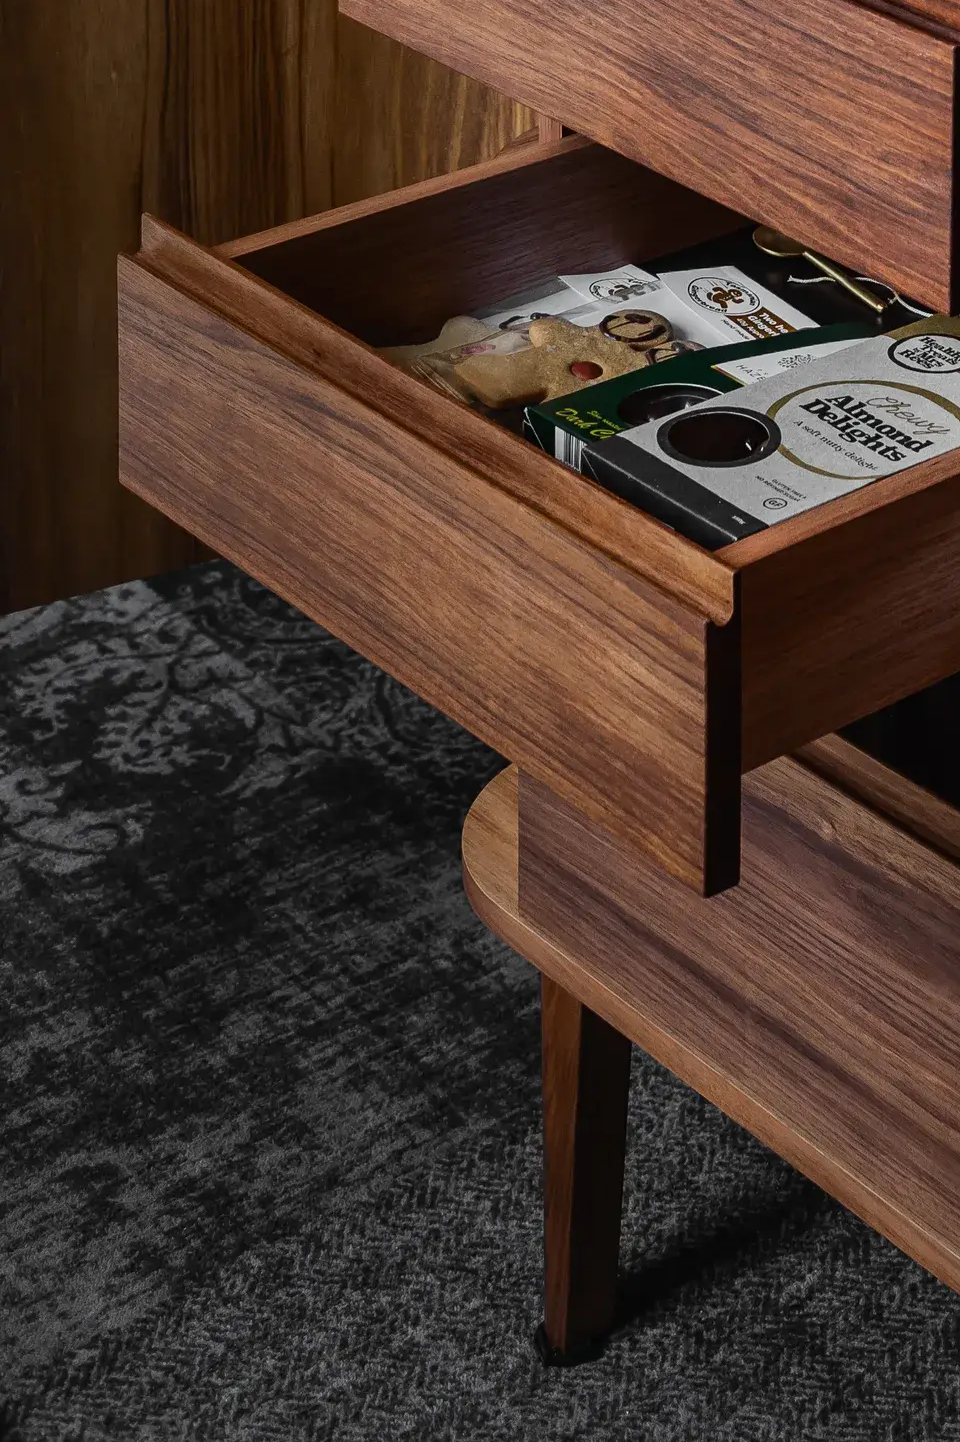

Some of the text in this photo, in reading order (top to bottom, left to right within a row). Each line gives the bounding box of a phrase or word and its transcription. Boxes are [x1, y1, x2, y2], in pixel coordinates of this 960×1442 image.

[759, 312, 777, 326] Two
[918, 351, 945, 368] Mrs
[920, 344, 958, 365] Treats
[825, 395, 934, 453] Almond
[865, 396, 952, 436] Chewy
[799, 398, 907, 463] Delights
[802, 424, 821, 438] soft
[819, 435, 847, 453] nutty
[844, 450, 879, 472] delight
[763, 479, 784, 494] REFINED
[782, 491, 800, 503] SUGAR
[772, 478, 790, 492] GLUTEN
[790, 488, 803, 498] FREE
[768, 499, 783, 508] GF
